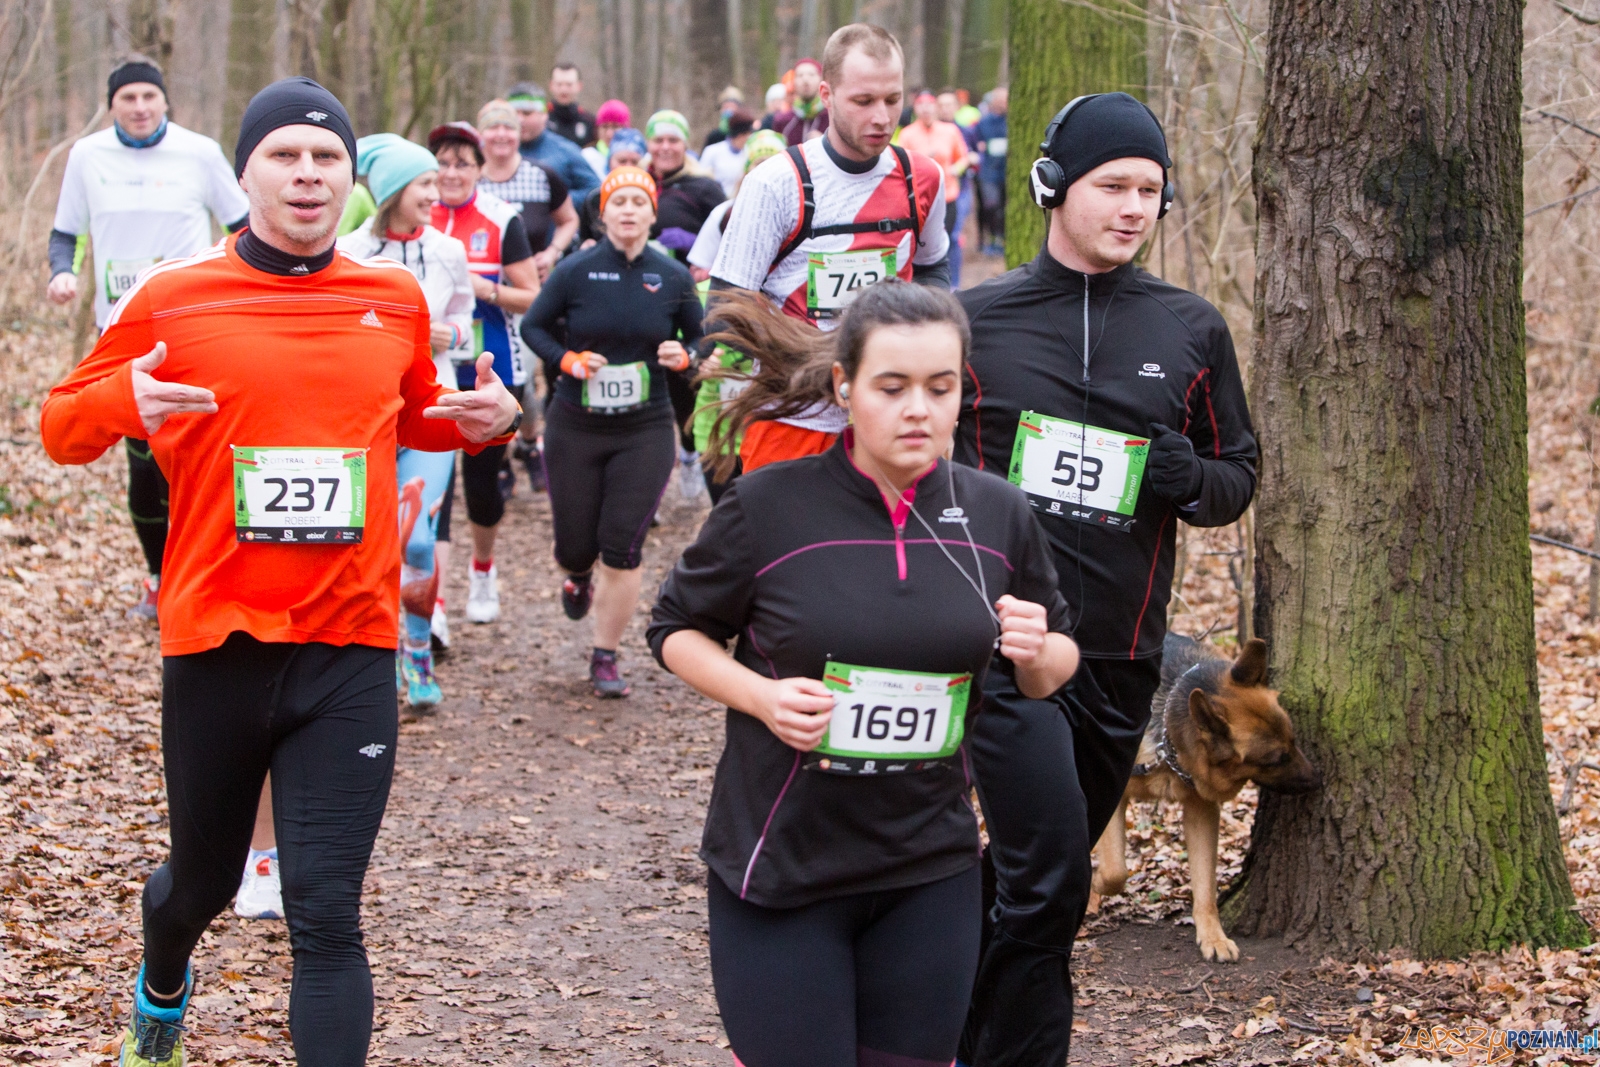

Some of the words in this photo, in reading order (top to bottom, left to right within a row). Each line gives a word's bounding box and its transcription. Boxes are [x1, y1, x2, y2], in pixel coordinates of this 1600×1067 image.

[305, 111, 328, 122] 4F
[598, 380, 633, 398] 103
[1051, 450, 1104, 492] 53
[263, 477, 341, 512] 237
[355, 485, 363, 517] Poznań
[1124, 474, 1138, 505] Poznań
[284, 516, 323, 526] ROBERT
[850, 703, 937, 742] 1691
[358, 742, 387, 758] 4F
